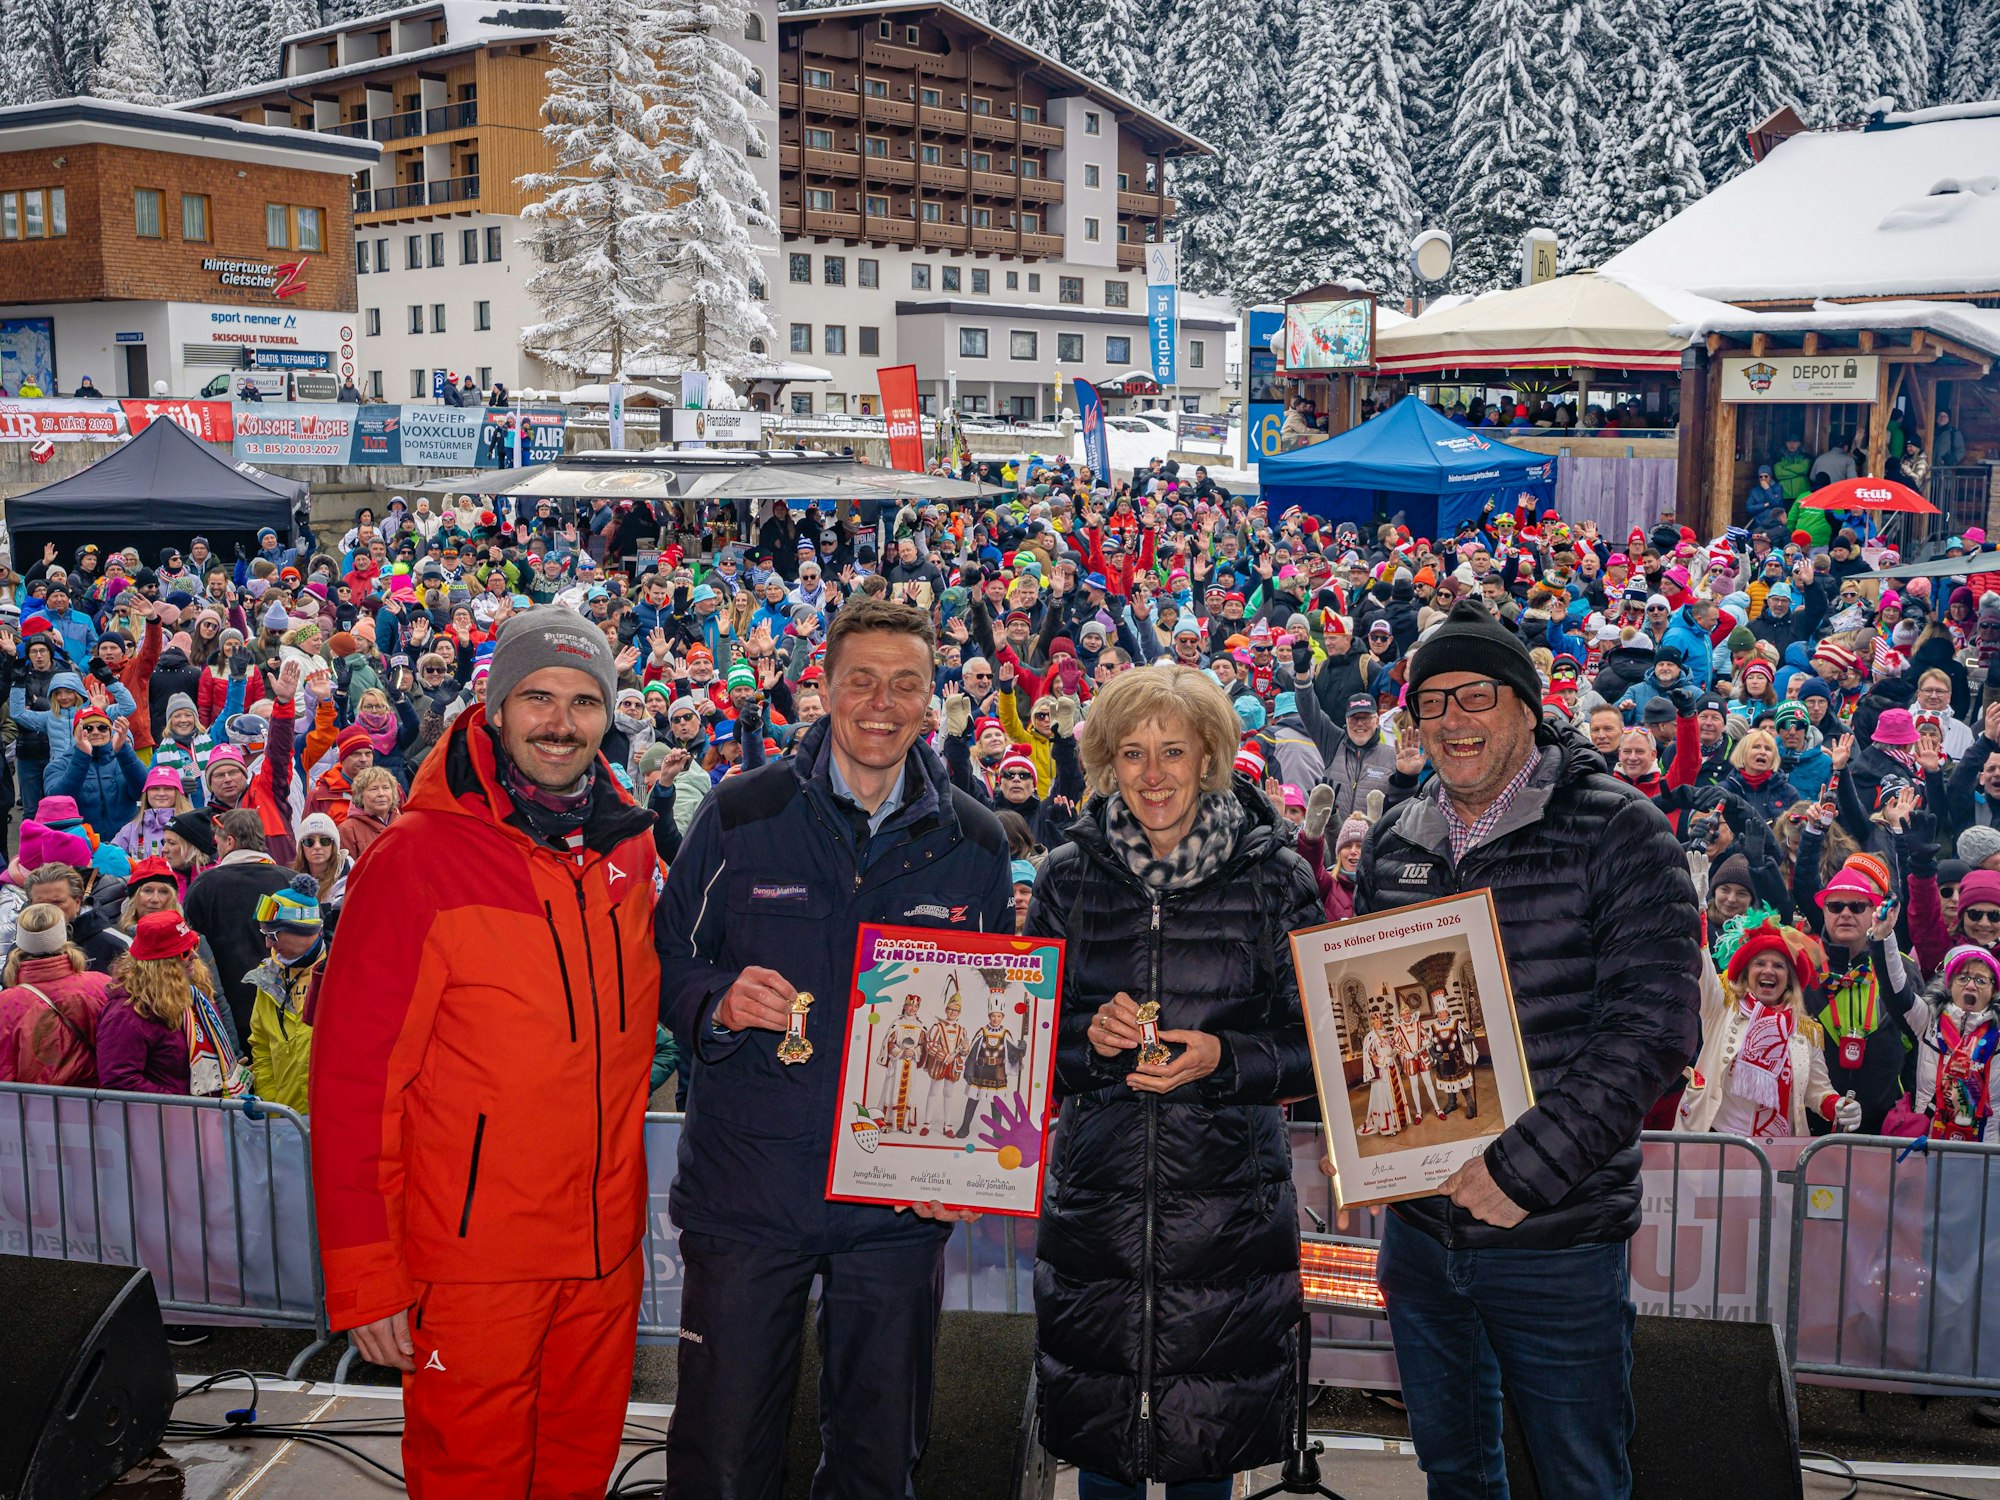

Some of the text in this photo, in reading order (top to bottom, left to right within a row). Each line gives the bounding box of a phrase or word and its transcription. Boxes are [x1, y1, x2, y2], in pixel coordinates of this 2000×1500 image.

[203, 258, 274, 275] Hintertuxer
[221, 273, 277, 288] Gletscher
[211, 312, 282, 325] sport nenner
[212, 333, 299, 345] SKISCHULE TUXERTAL
[257, 353, 279, 364] GRATIS
[281, 354, 316, 365] TIEFGARAGE
[1793, 365, 1839, 379] DEPOT
[1124, 381, 1160, 394] HOTEL
[42, 415, 113, 431] 27. MÄRZ 2026
[203, 406, 212, 437] KÖLSCH
[236, 412, 349, 437] KÖLSCHE WOCHE
[706, 414, 741, 427] Franziskaner
[290, 432, 328, 441] Hintertux
[402, 425, 476, 438] VOXXCLUB
[535, 427, 564, 448] AIR
[1262, 413, 1281, 457] 6
[246, 443, 339, 455] 13. BIS 20.03.2027
[404, 440, 473, 450] DOMSTÜRMER
[419, 450, 458, 460] RABAUE
[1854, 487, 1892, 501] früh
[753, 886, 806, 897] Dengg Matthias
[1323, 914, 1461, 952] Das Kölner Dreigestirn 2026
[876, 940, 936, 950] DAS KÖLNER
[875, 948, 1041, 969] KINDERDREIGESTIRN
[1006, 969, 1043, 982] 2026
[853, 1170, 897, 1181] Jungfrau Phili
[910, 1175, 927, 1184] Prinz
[928, 1176, 945, 1185] Linus
[966, 1180, 1016, 1191] Bauer Jonathan
